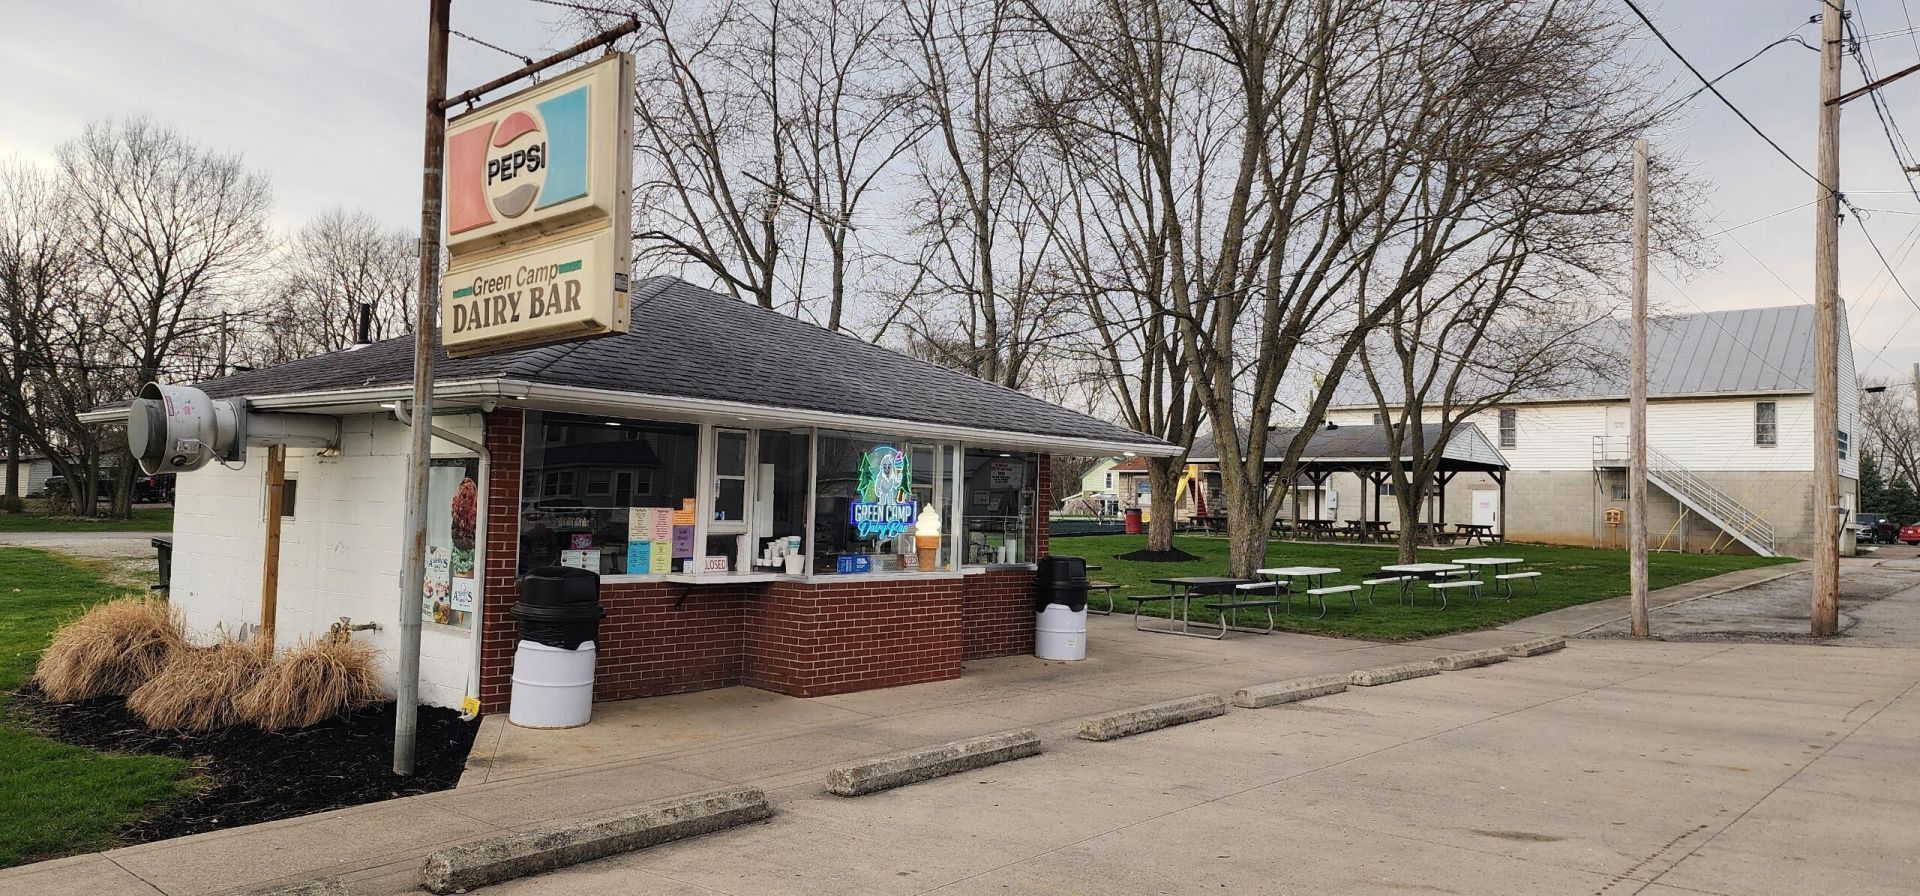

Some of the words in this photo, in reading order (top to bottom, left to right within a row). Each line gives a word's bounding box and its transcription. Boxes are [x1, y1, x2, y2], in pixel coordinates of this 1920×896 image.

[488, 141, 546, 186] PEPSI
[472, 274, 512, 297] Green
[516, 263, 558, 287] Camp
[453, 290, 522, 334] DAIRY
[529, 279, 581, 319] BAR
[855, 504, 884, 522] GREEN
[886, 505, 912, 522] CAMP
